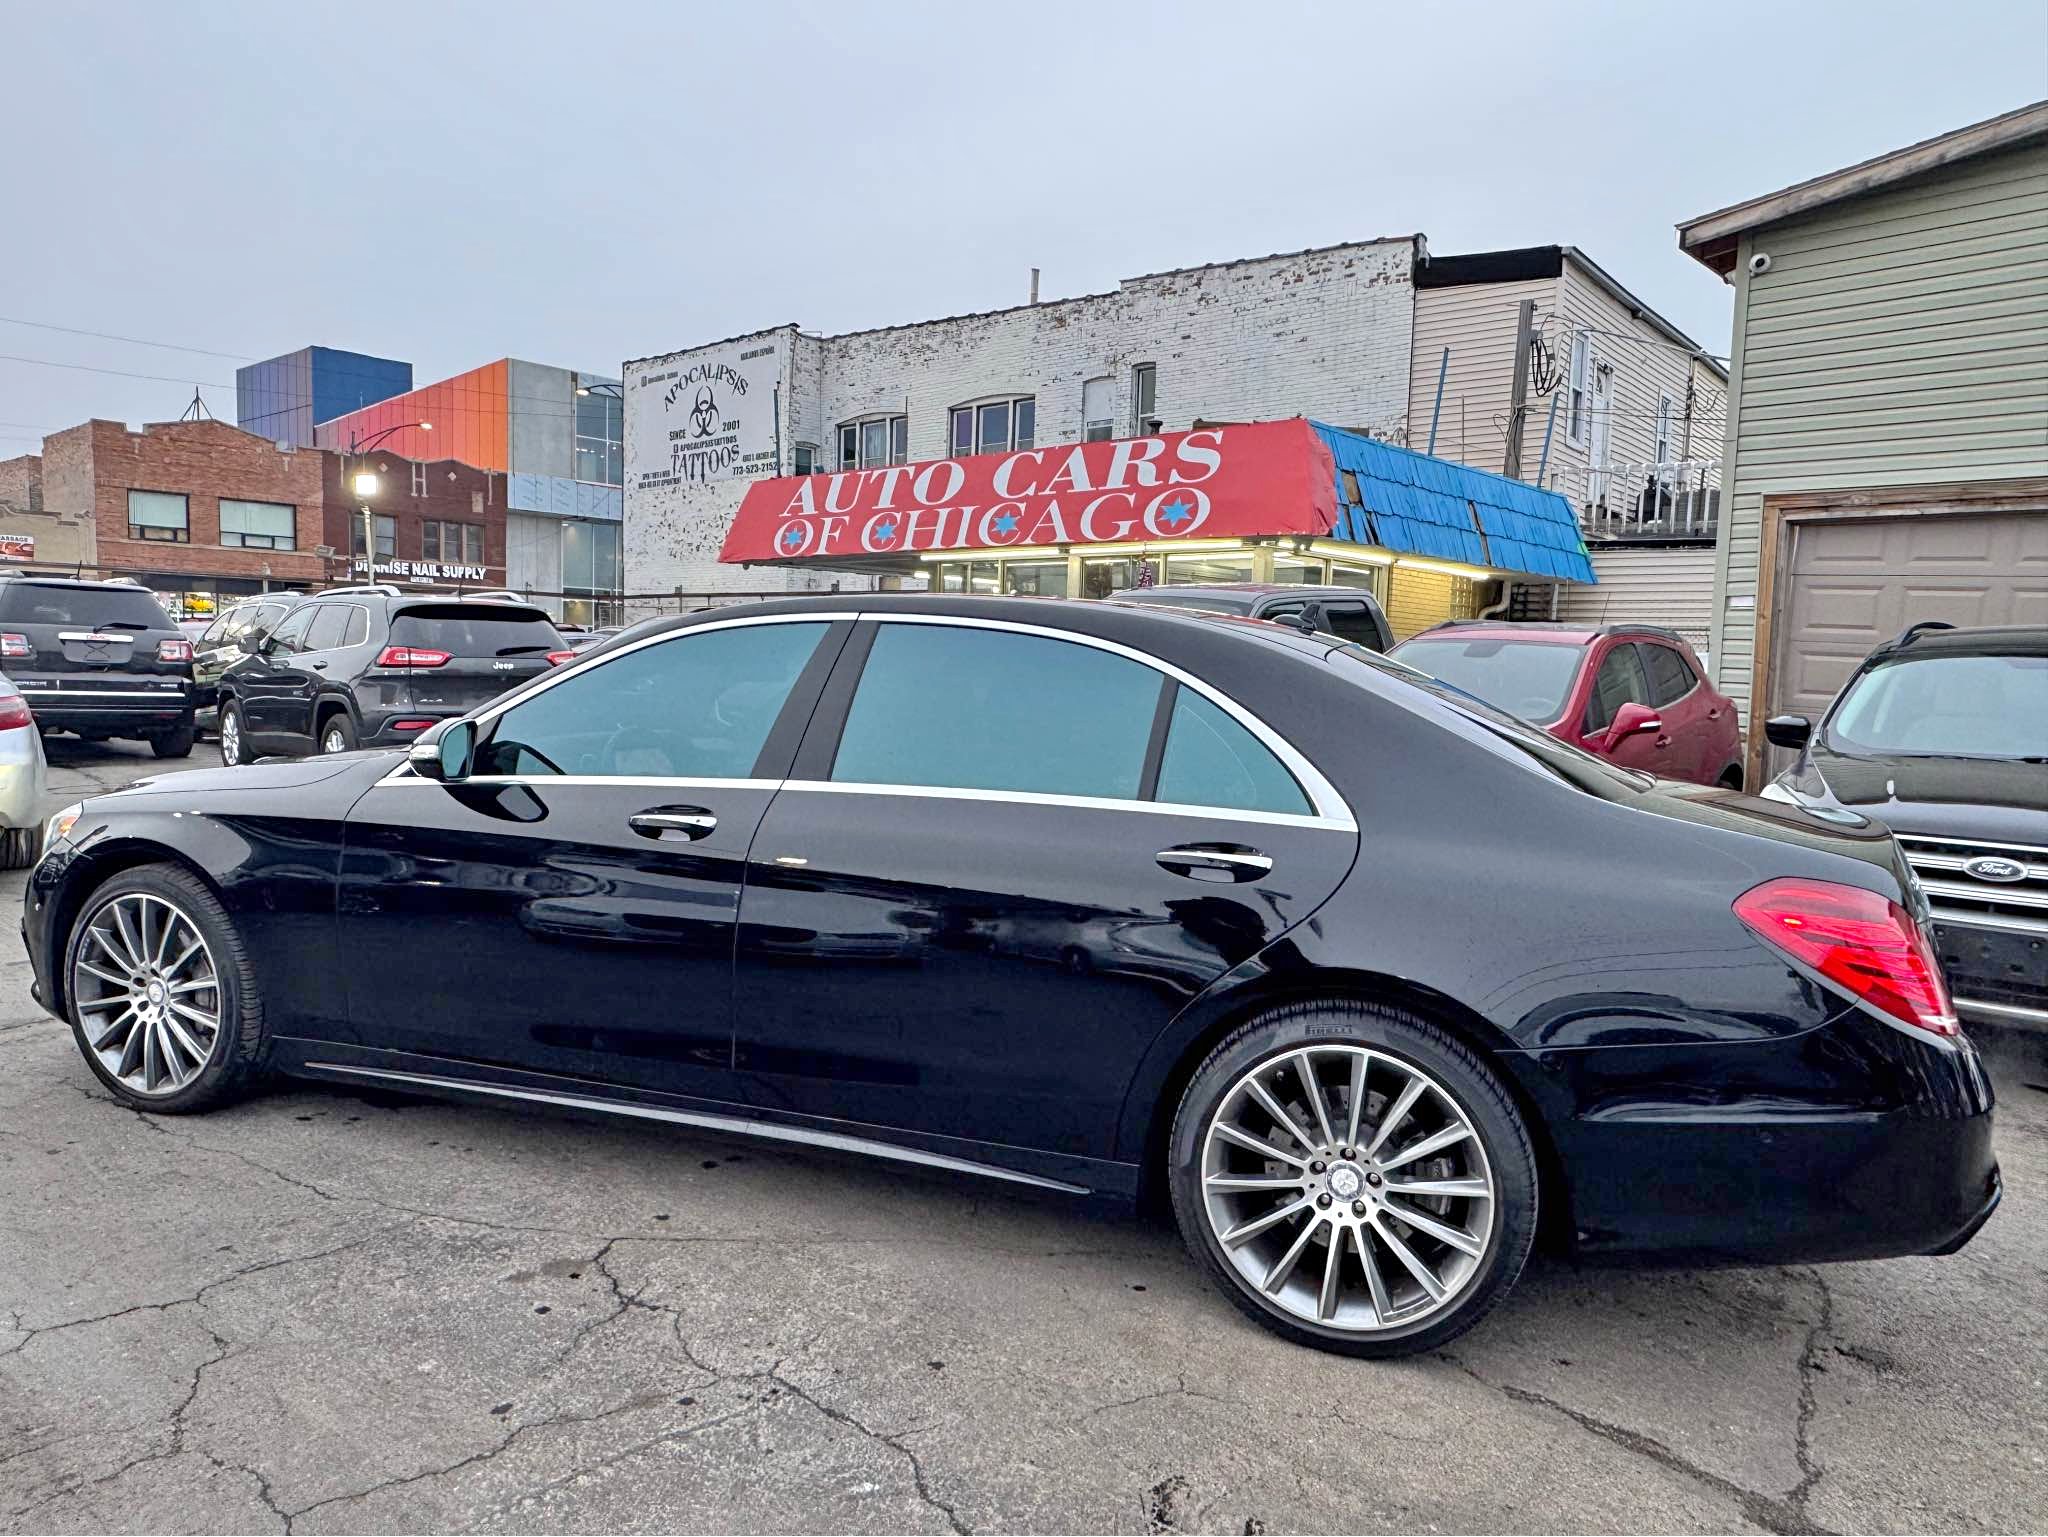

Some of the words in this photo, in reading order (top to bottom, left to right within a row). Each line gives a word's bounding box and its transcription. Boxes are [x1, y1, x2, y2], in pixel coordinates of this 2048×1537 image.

[664, 362, 749, 412] APOCALIPSIS
[669, 429, 687, 441] SINCE
[722, 419, 740, 432] 2001
[670, 444, 740, 484] TATTOOS
[732, 461, 777, 476] 773-523-2152
[779, 461, 965, 517] AUTO
[992, 431, 1224, 499] CARS
[773, 515, 850, 557] OF
[861, 487, 1211, 553] CHICAGO
[412, 562, 441, 577] NAIL
[442, 565, 487, 580] SUPPLY
[493, 661, 514, 670] Jeep
[1978, 862, 2012, 875] Ford
